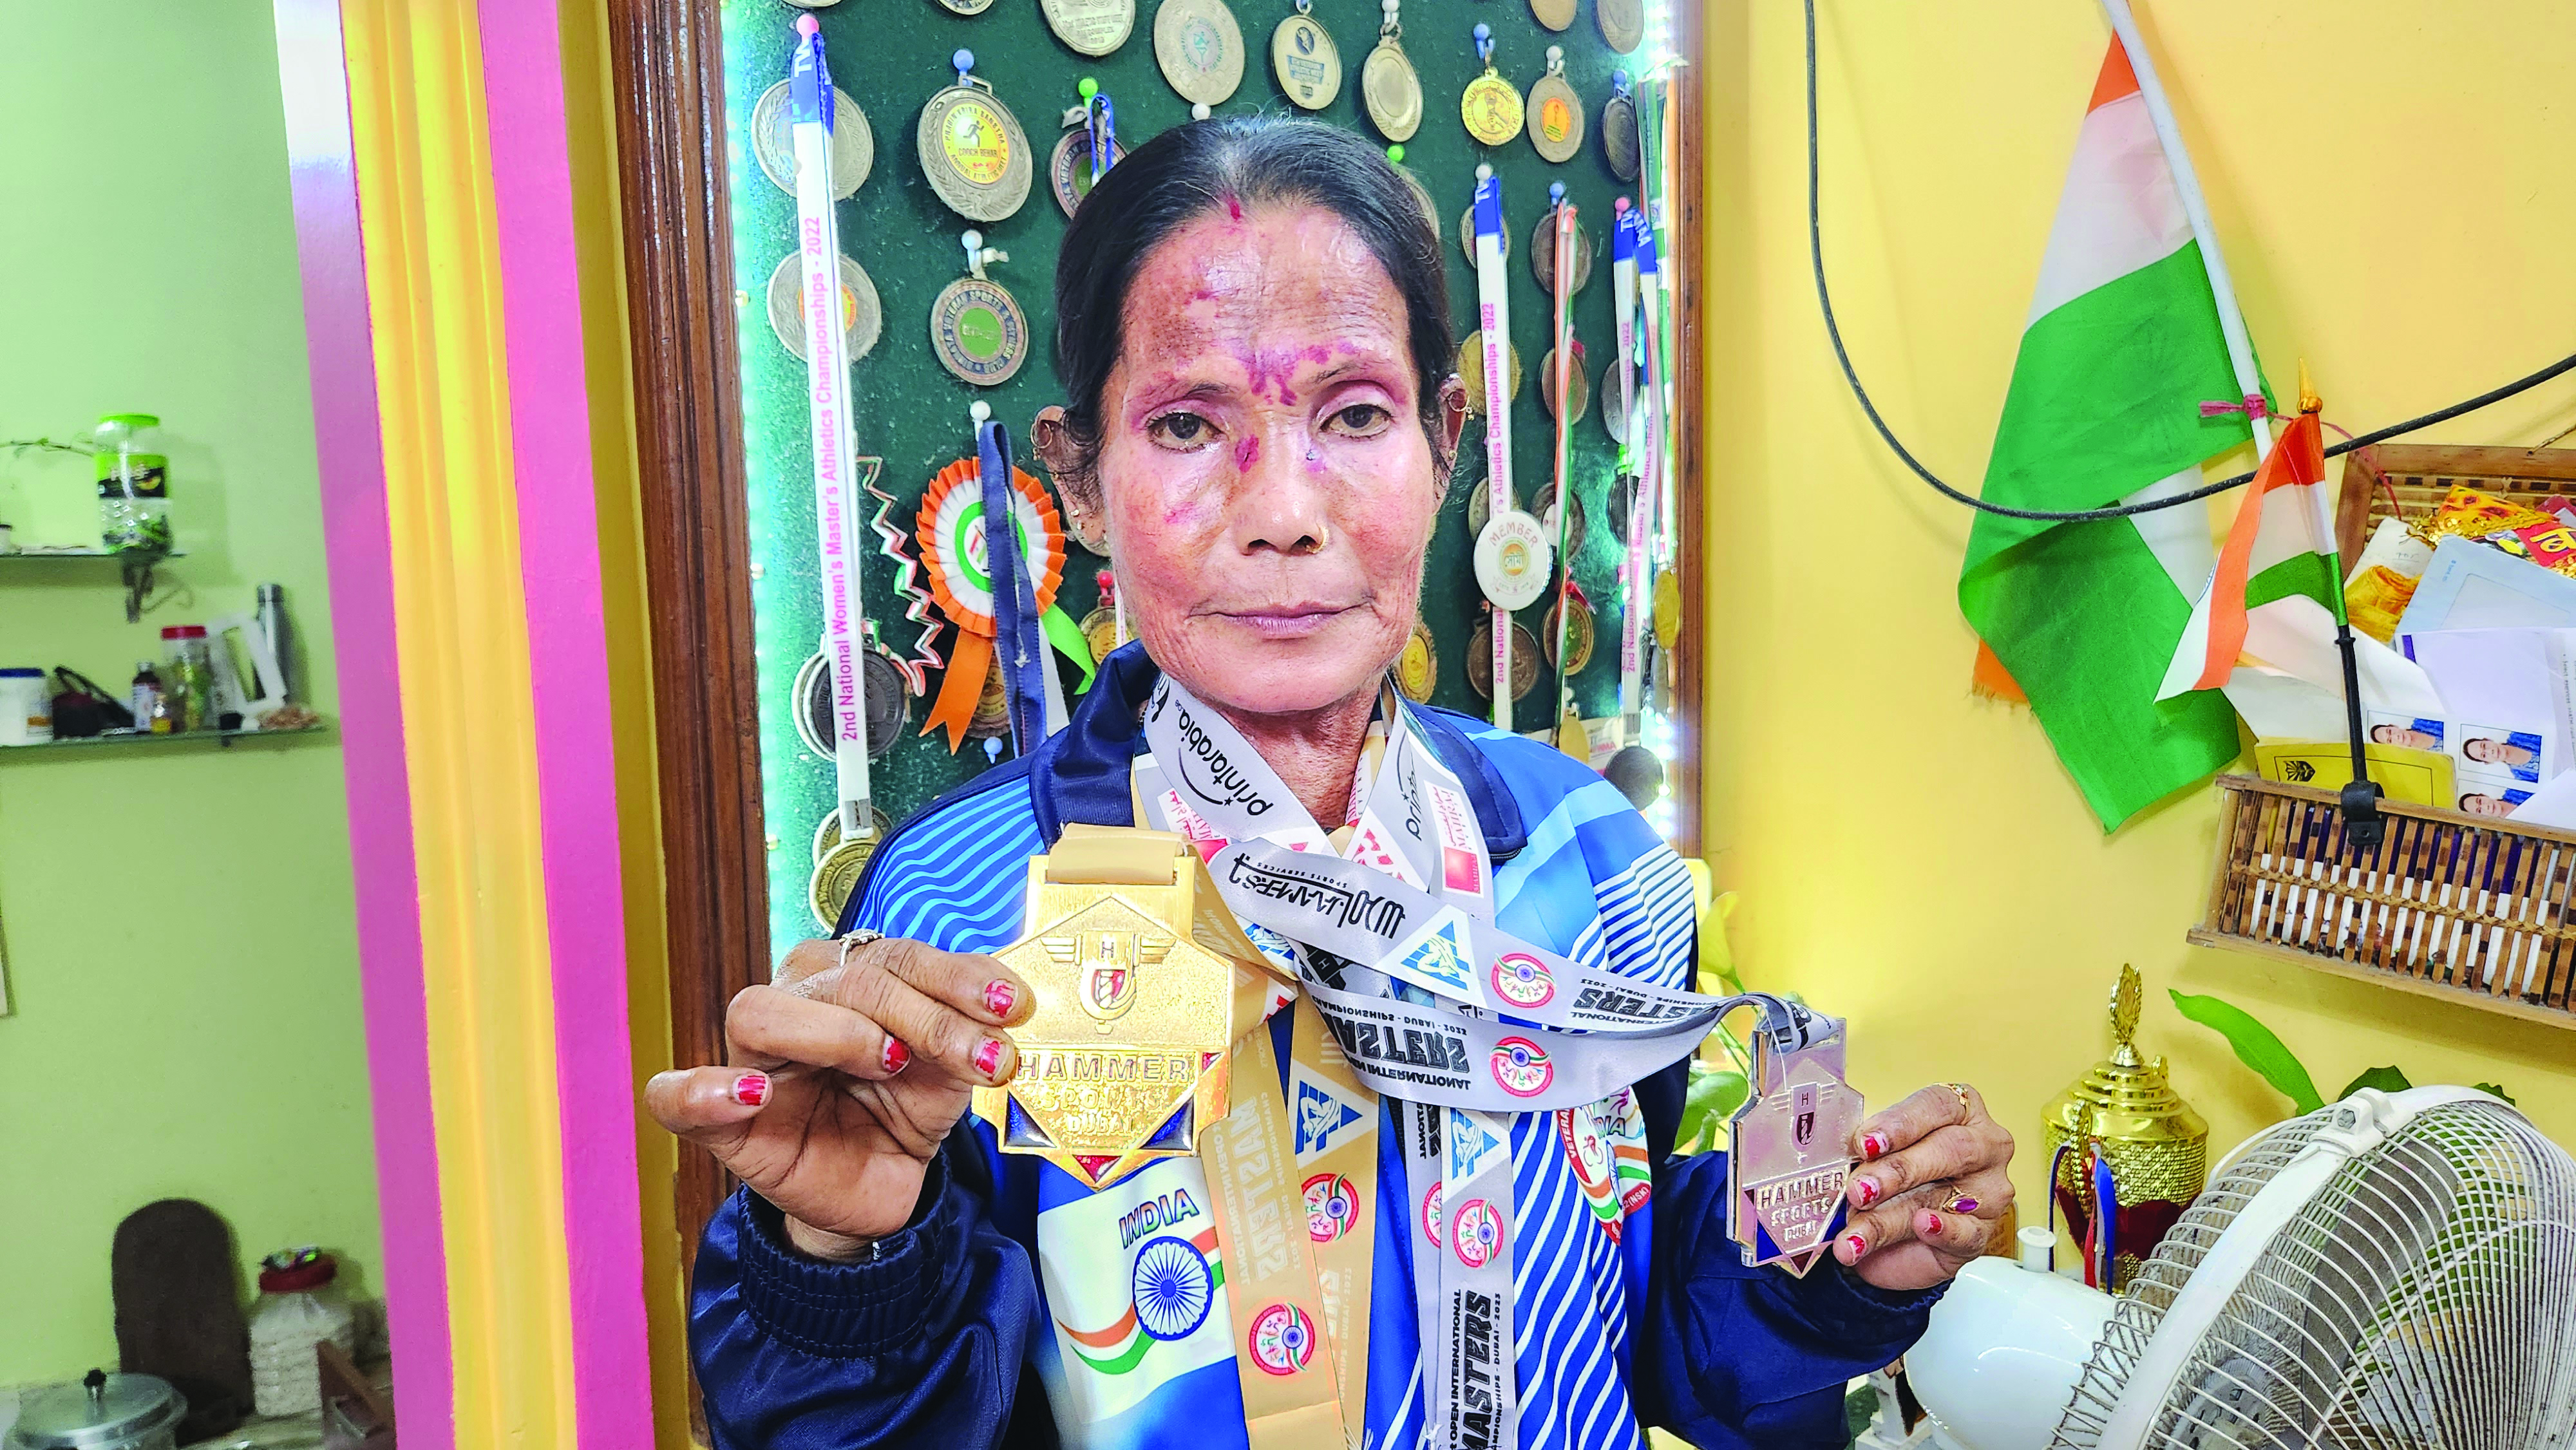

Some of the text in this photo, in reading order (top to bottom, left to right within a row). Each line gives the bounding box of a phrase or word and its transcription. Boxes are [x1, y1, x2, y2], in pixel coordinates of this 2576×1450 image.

[804, 217, 822, 256] 2022
[1481, 303, 1495, 331] 2022
[810, 272, 833, 403] Championships
[1485, 343, 1502, 438] Championships
[816, 410, 837, 481] Athletics
[1490, 443, 1503, 495] Athletics
[822, 486, 842, 555] Master's
[1489, 522, 1538, 548] MEMBER
[828, 560, 848, 635] Women's
[1493, 608, 1504, 658] National
[1627, 604, 1635, 672] 2nd National
[835, 639, 854, 706] National
[1495, 662, 1505, 683] 2nd
[840, 711, 857, 740] 2nd
[1256, 862, 1348, 889] SPORTS SERVICES
[1101, 941, 1115, 959] H
[1580, 978, 1607, 988] 2023
[1615, 986, 1647, 998] DUBAI
[1573, 988, 1703, 1019] STERS
[1017, 1053, 1190, 1082] HAMMER
[1041, 1086, 1168, 1110] SPORTS
[1801, 1091, 1809, 1106] H
[1066, 1113, 1135, 1135] DUBAI
[1561, 1109, 1577, 1158] VETERA
[1760, 1171, 1844, 1208] HAMMER
[1119, 1188, 1199, 1250] INDIA
[1770, 1198, 1831, 1227] SPORTS
[1783, 1220, 1817, 1243] DUBAI
[1344, 1268, 1352, 1296] 2023
[1343, 1303, 1351, 1343] DUBAI
[1451, 1289, 1461, 1399] INTERNATIONAL
[1450, 1402, 1459, 1441] OPEN
